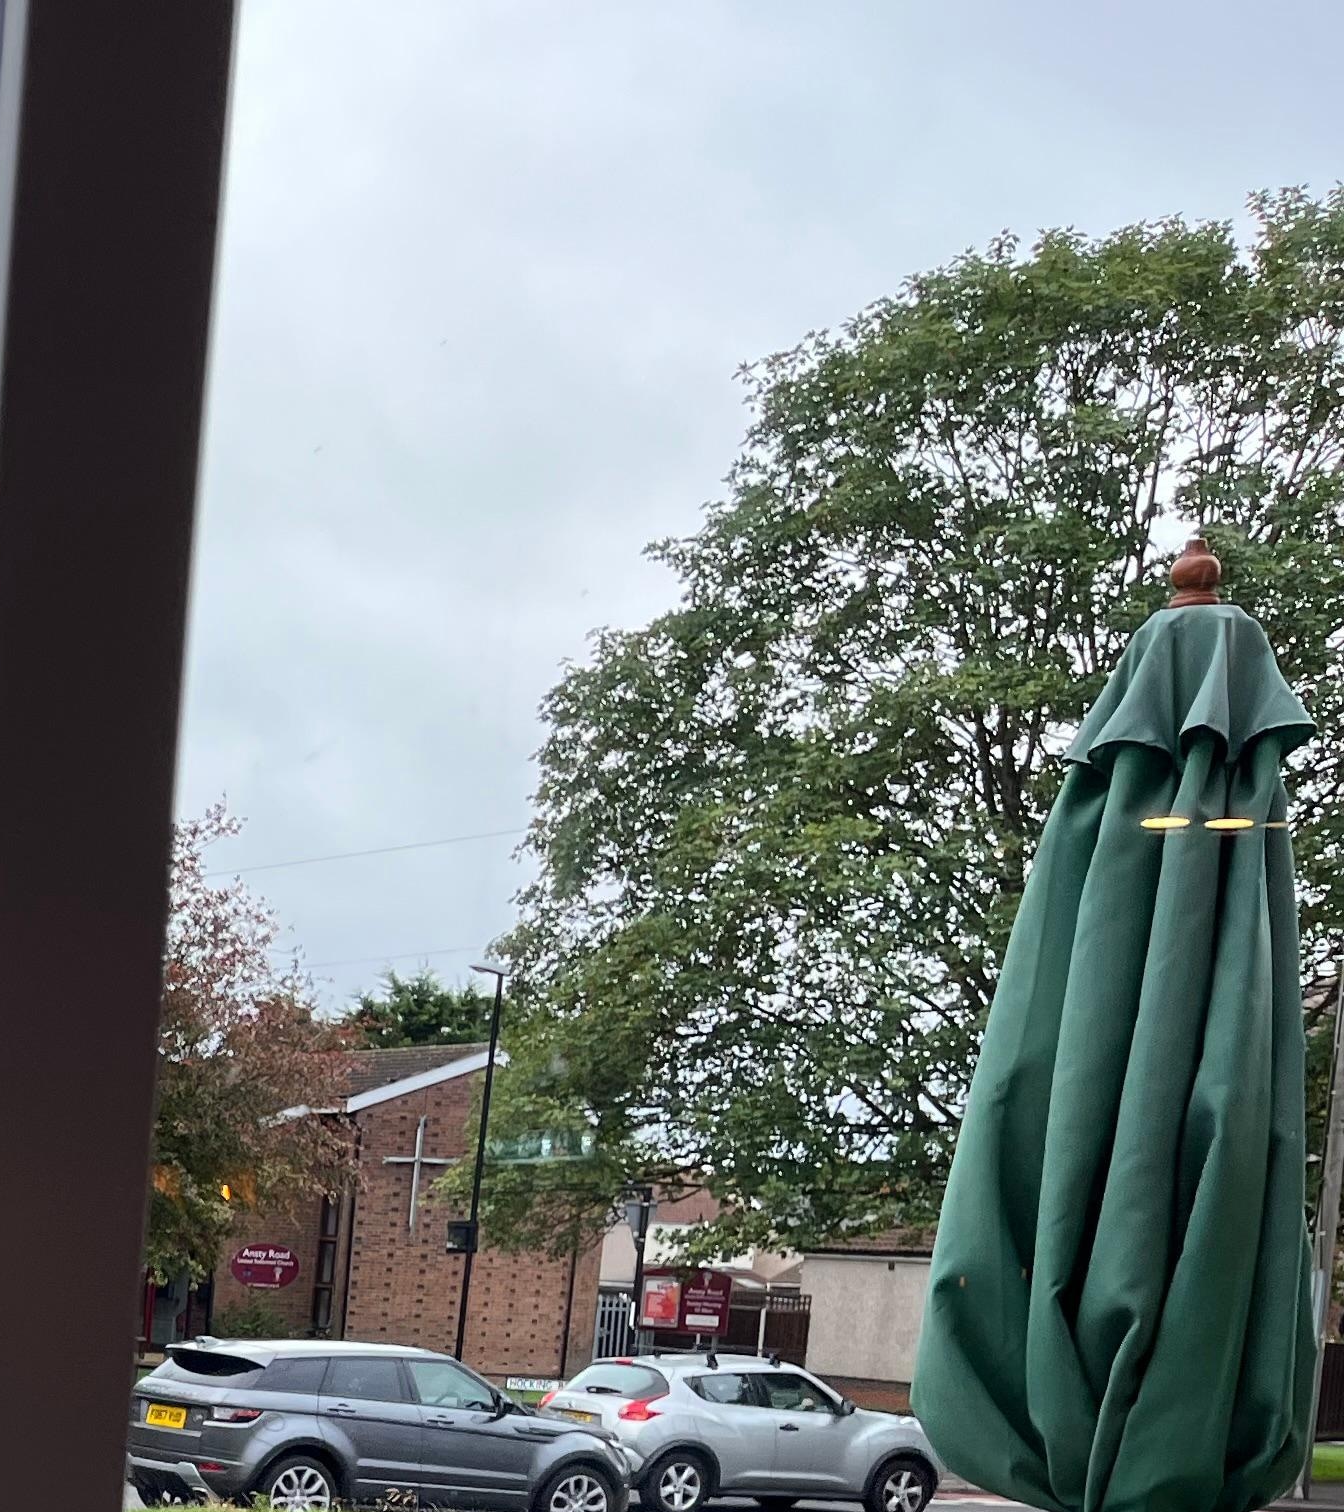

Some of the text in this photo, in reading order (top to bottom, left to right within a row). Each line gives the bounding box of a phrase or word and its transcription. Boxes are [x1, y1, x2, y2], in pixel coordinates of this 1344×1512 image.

[242, 1248, 291, 1261] Ansty Road
[509, 1377, 551, 1390] HOCKING
